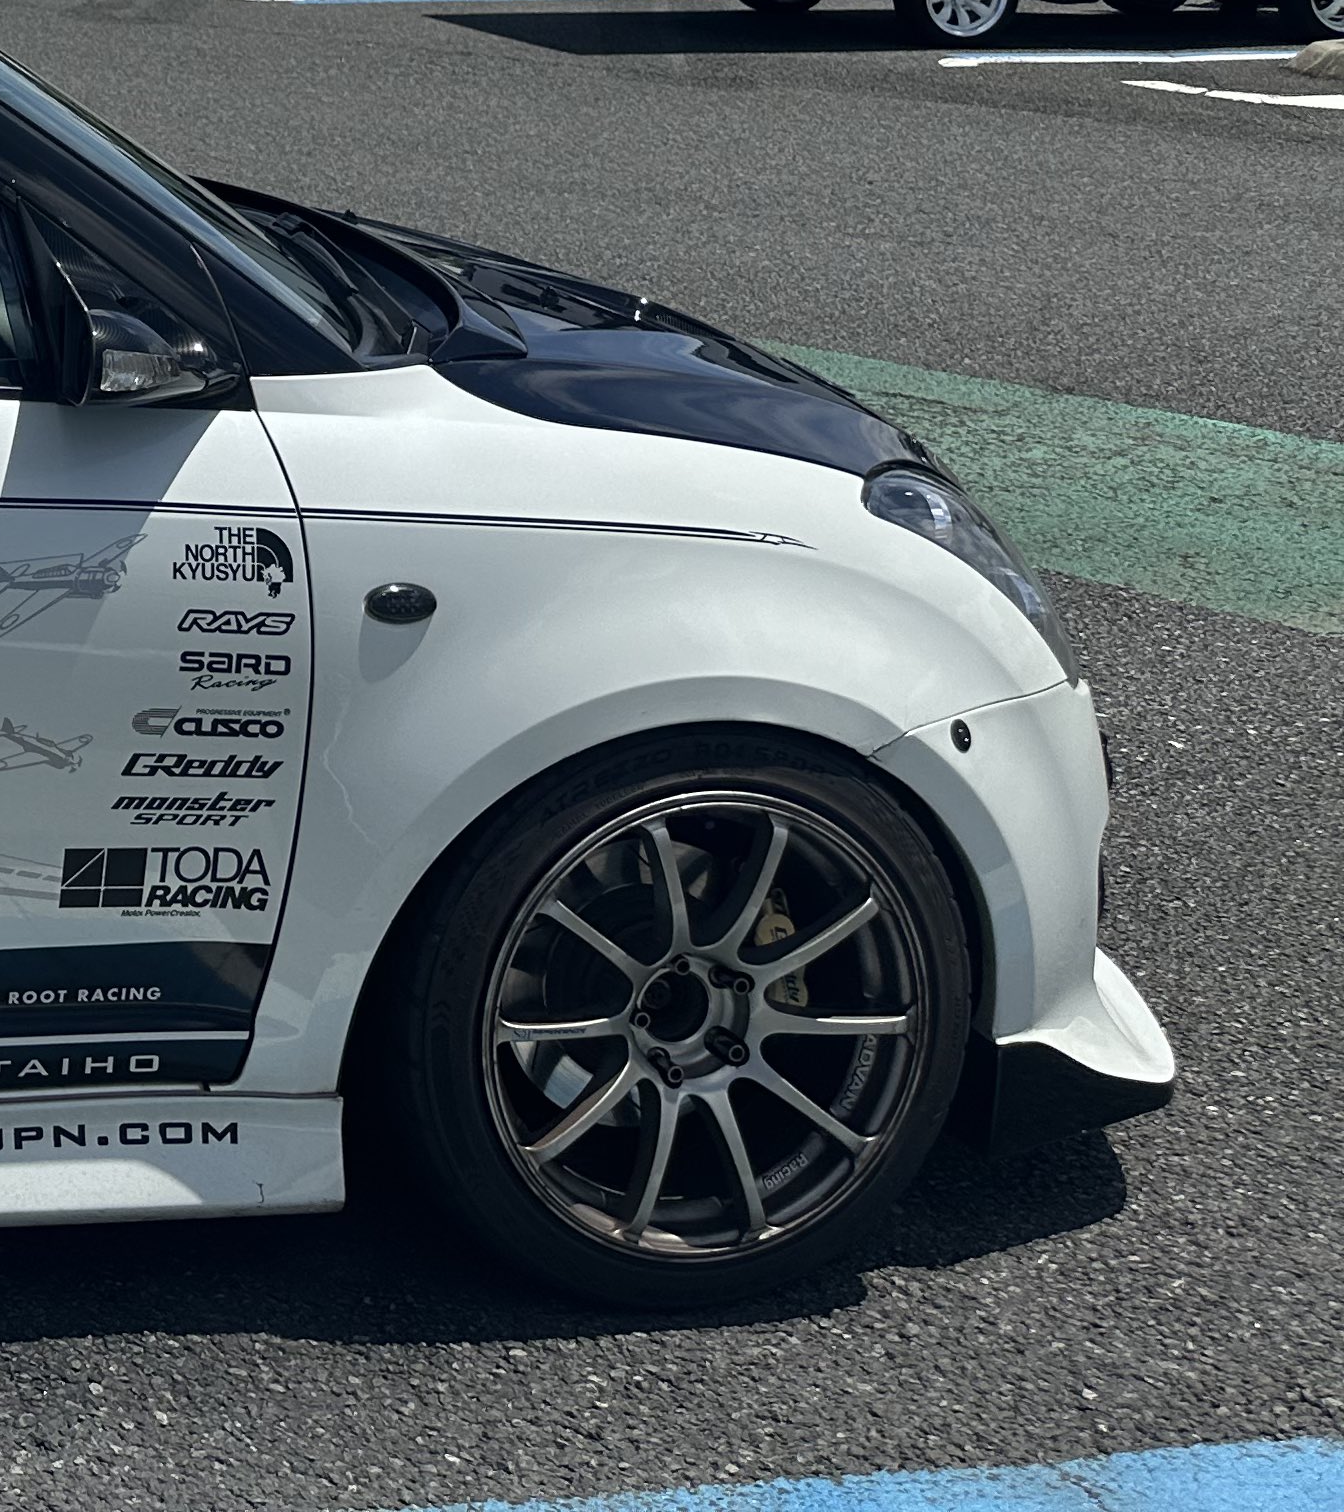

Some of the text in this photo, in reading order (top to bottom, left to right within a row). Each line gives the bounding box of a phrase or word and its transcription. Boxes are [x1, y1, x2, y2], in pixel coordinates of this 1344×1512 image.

[214, 526, 255, 545] THE
[185, 544, 255, 563] NORTH
[172, 562, 255, 582] KYUSYU
[177, 609, 296, 635] RAYS
[190, 674, 277, 691] Racing
[121, 753, 284, 779] GReddy
[111, 791, 276, 812] monster
[130, 812, 249, 827] SPORT
[150, 846, 272, 886] TODA
[144, 884, 270, 912] RACING
[8, 989, 67, 1005] ROOT
[77, 986, 162, 1003] RACING
[763, 1151, 809, 1189] Racing
